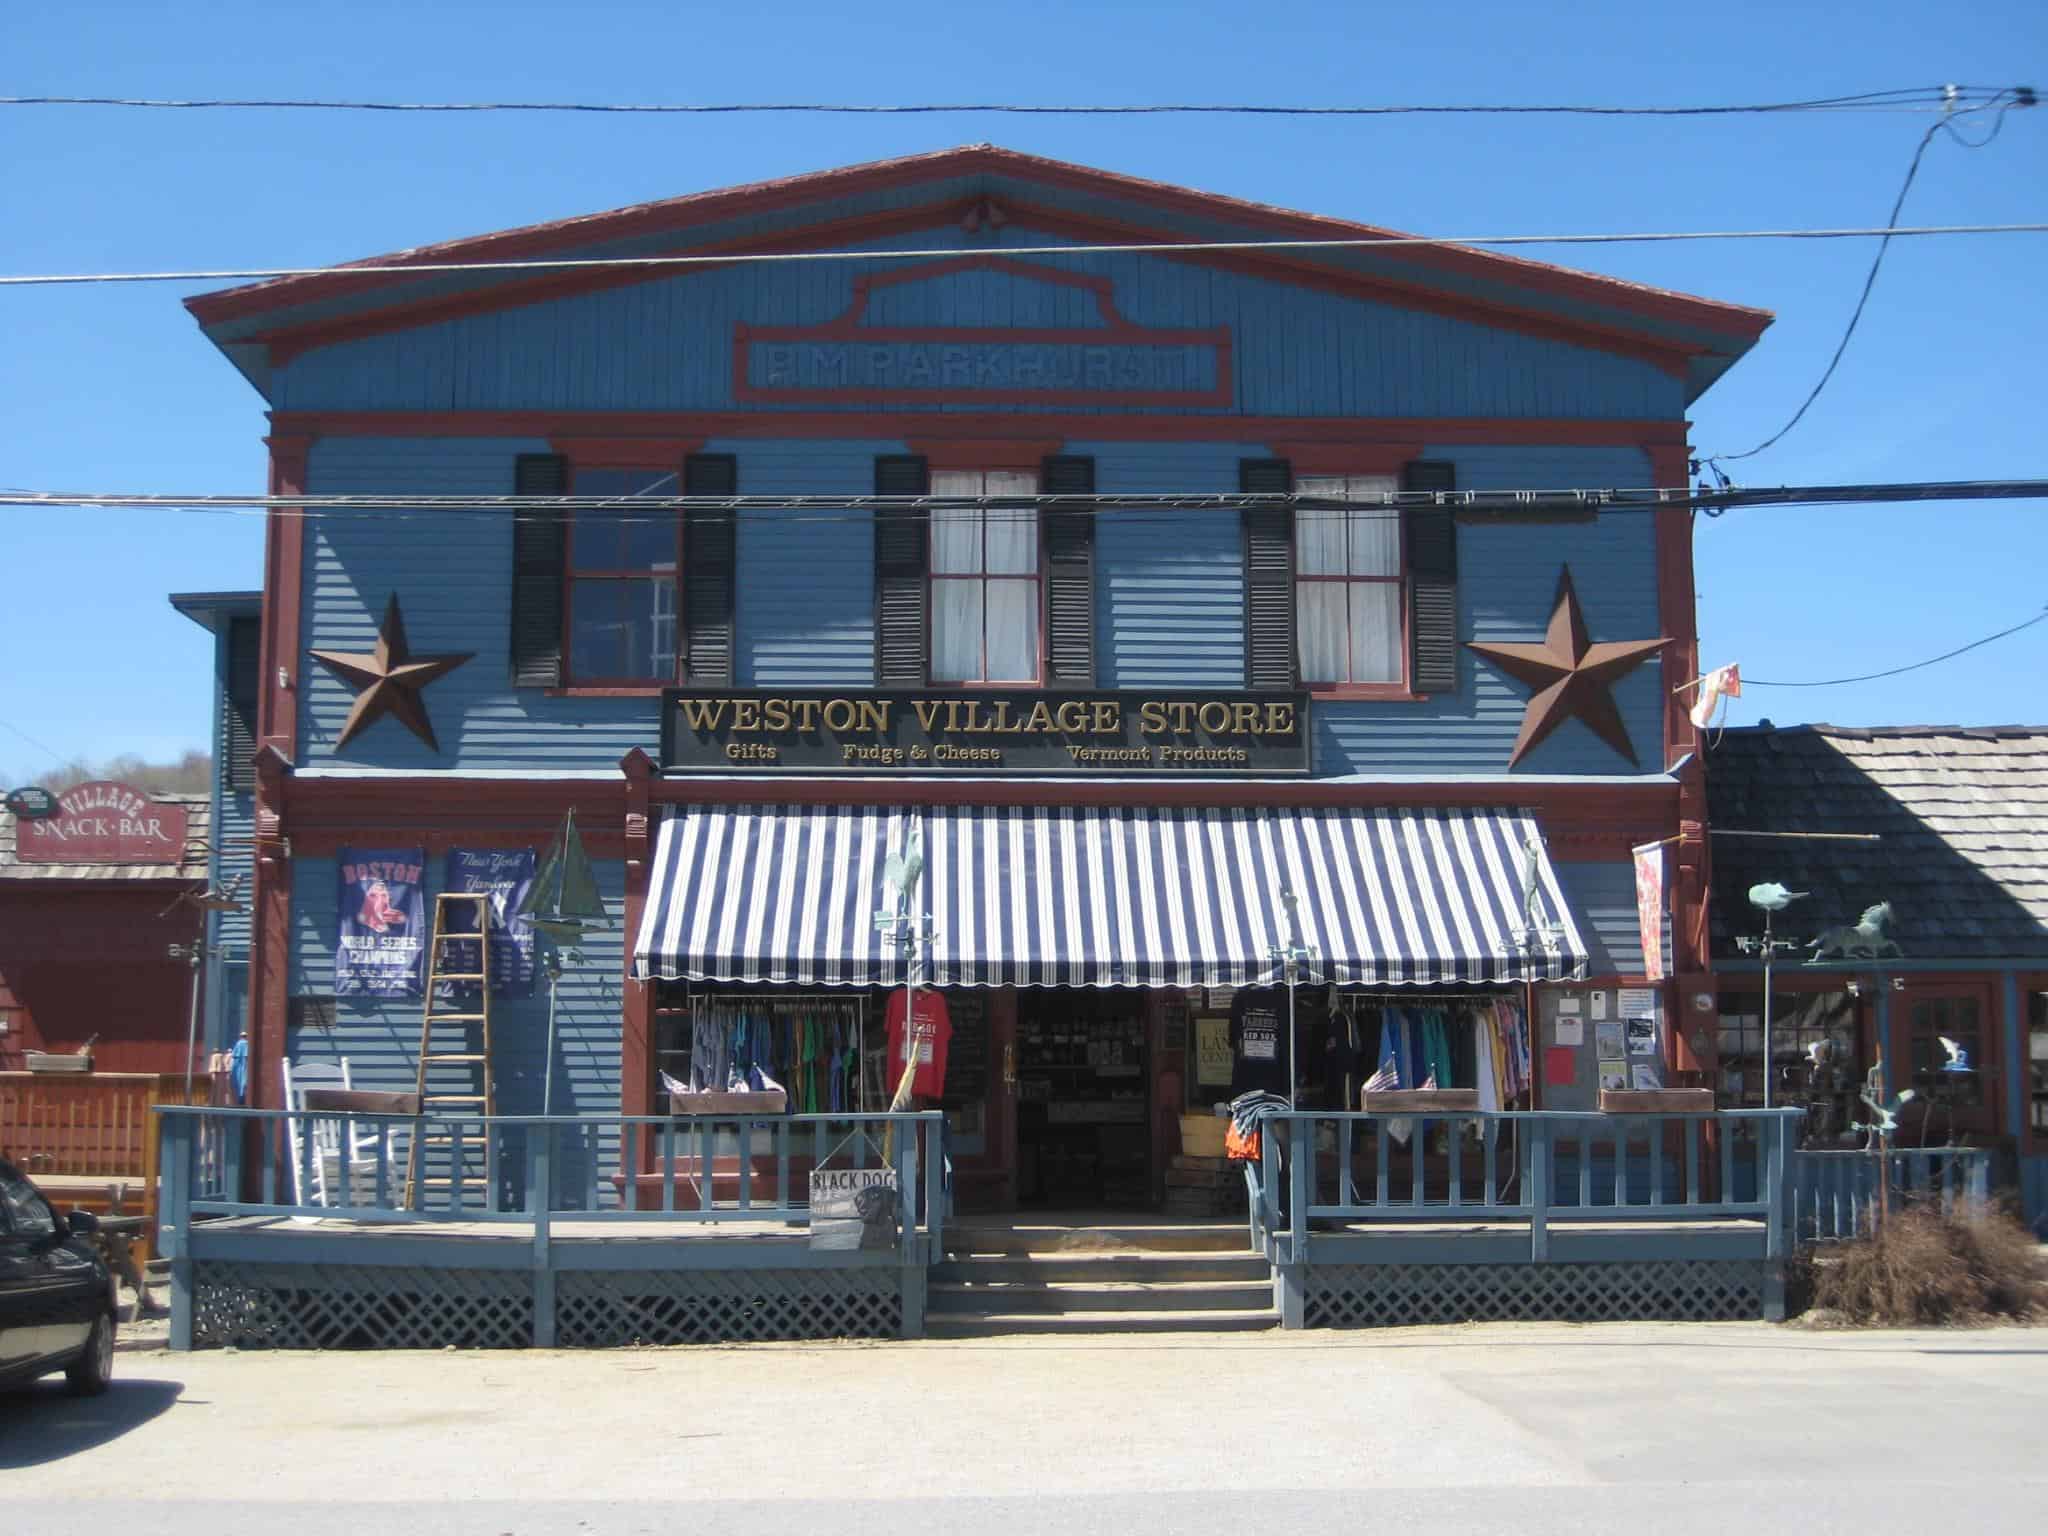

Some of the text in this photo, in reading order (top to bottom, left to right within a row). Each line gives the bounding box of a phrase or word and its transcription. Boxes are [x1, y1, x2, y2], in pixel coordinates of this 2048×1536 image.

[678, 699, 1294, 734] WESTON VILLAGE STORE
[726, 743, 778, 760] Gifts
[842, 743, 1000, 764] Fudge & Cheese
[1065, 745, 1246, 762] Vermont Products
[61, 787, 144, 818] VILLAGE
[32, 819, 173, 841] SNACK BAR
[342, 861, 422, 885] BOSTON
[813, 1172, 858, 1191] BLACK
